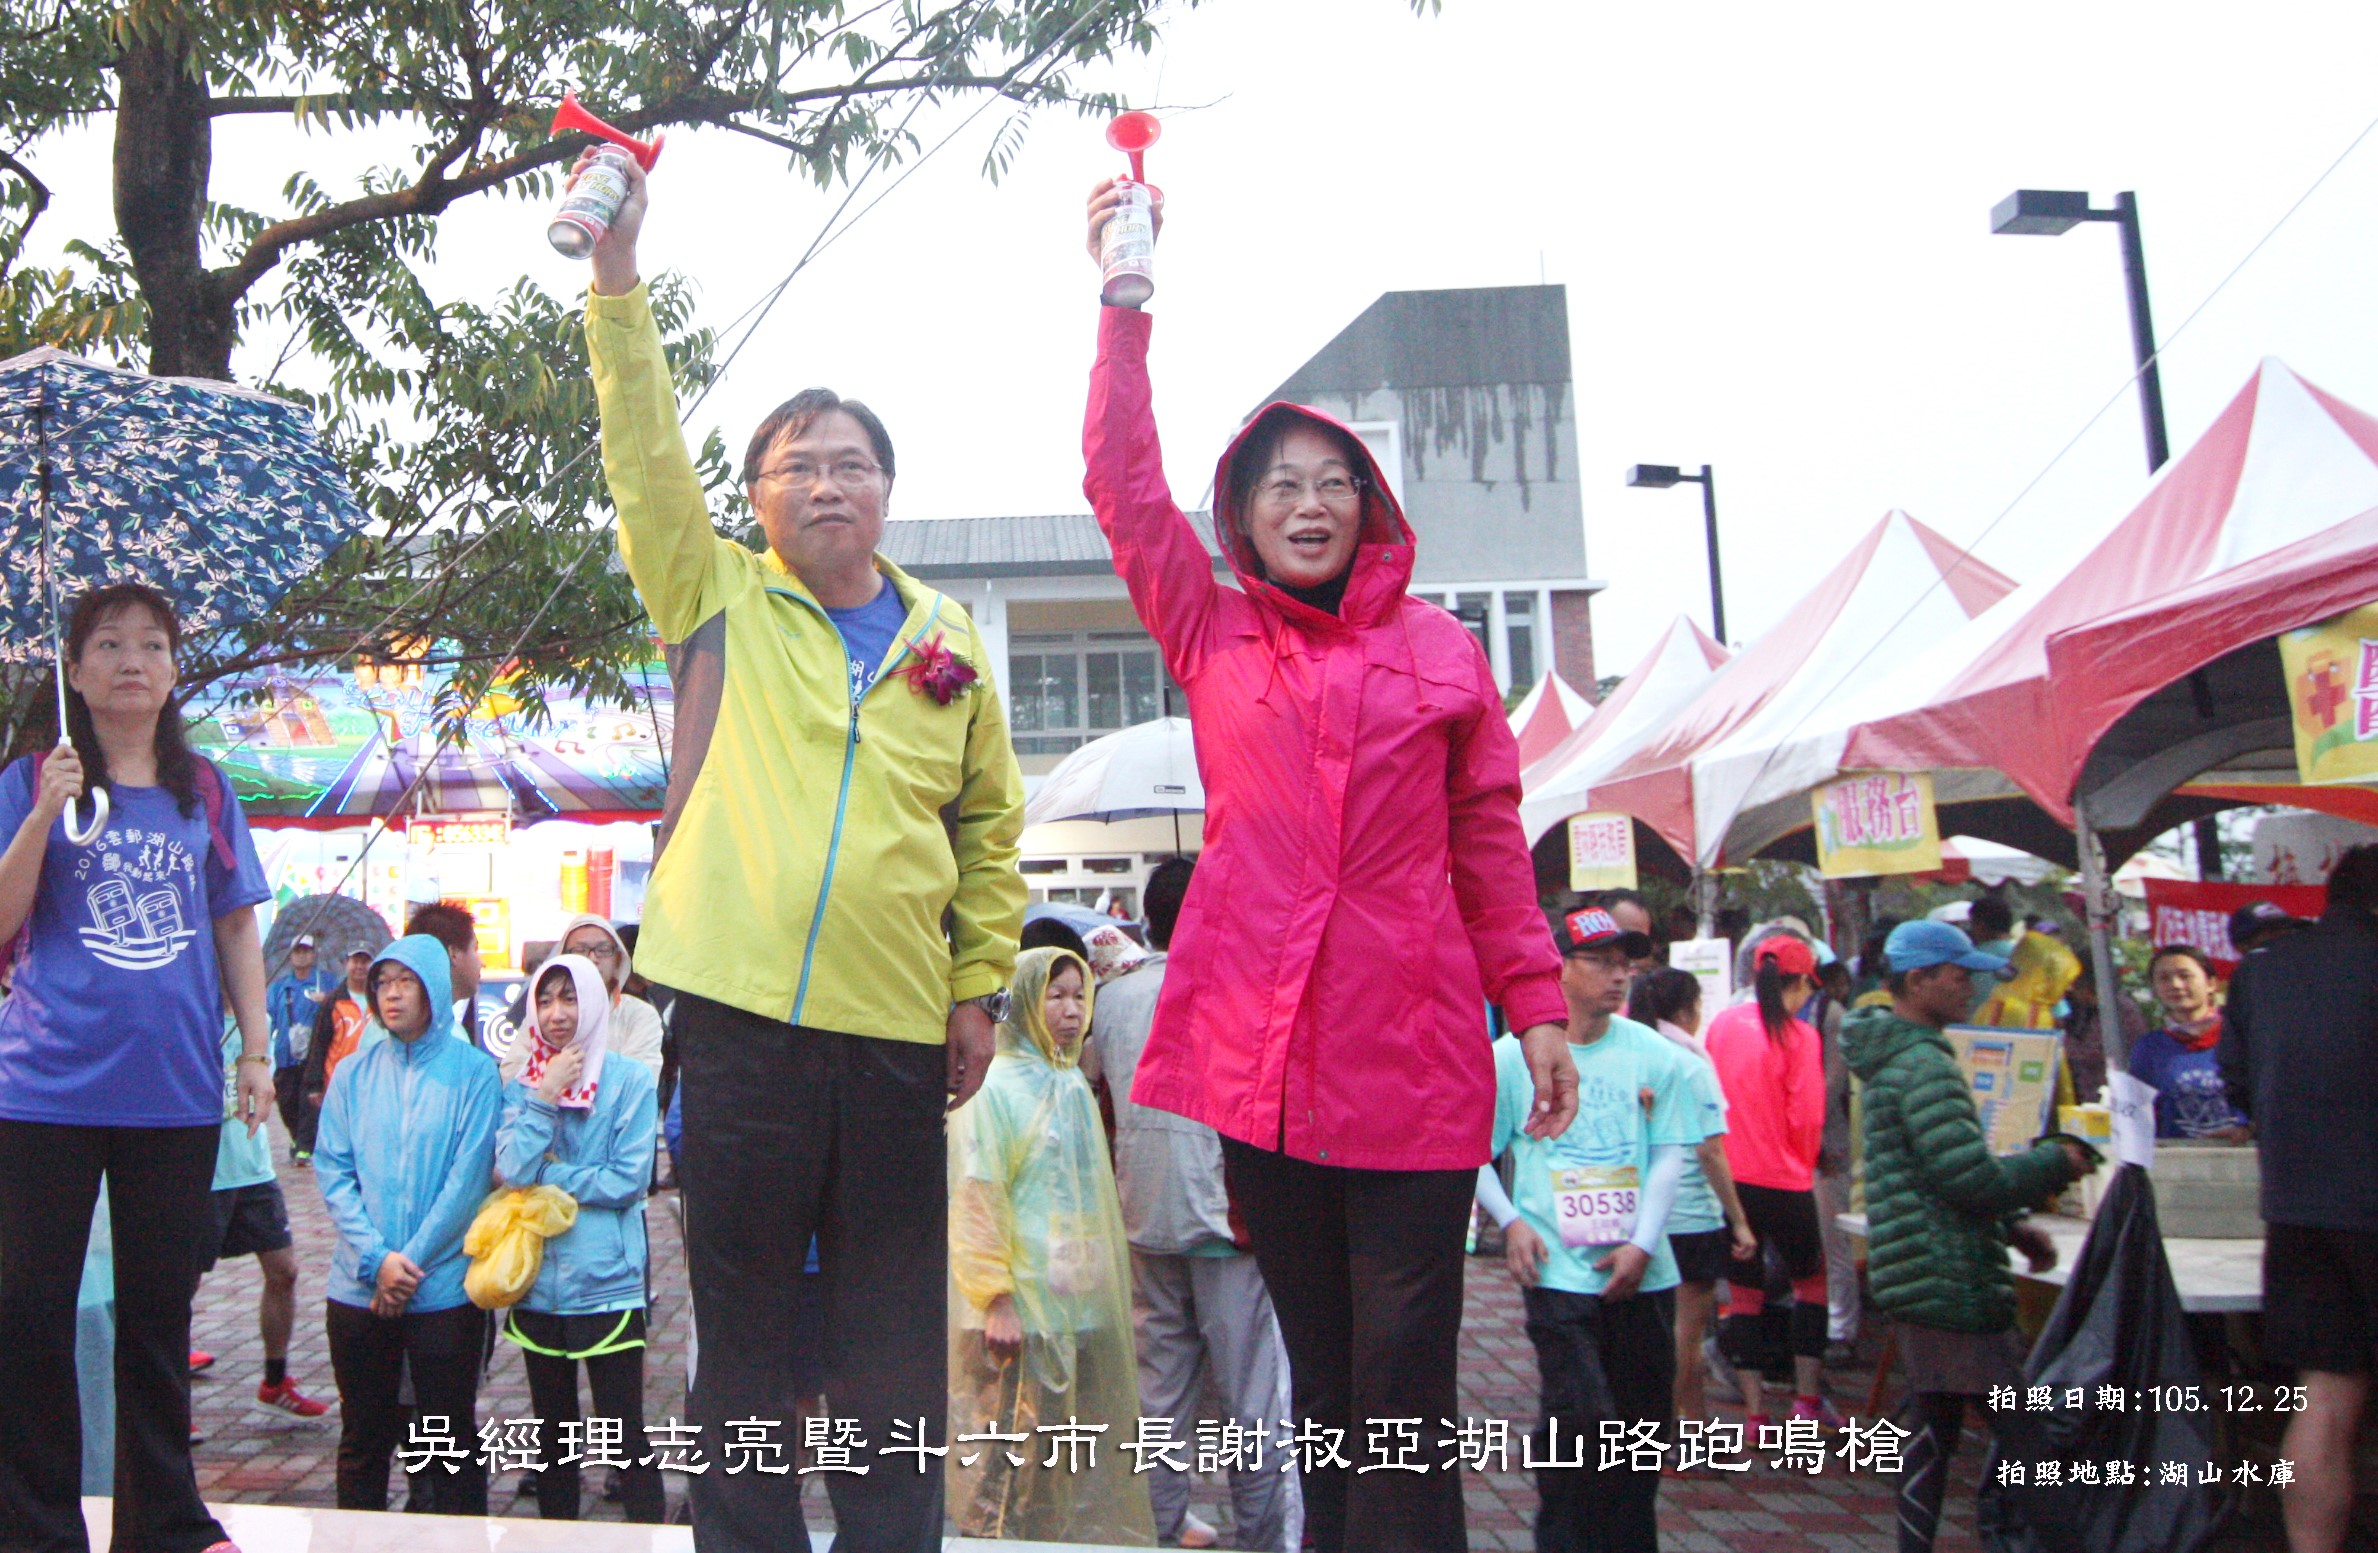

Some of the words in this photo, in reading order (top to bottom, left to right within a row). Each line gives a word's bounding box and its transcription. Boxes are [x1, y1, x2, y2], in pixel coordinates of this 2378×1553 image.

[1836, 772, 1921, 842] 服務台
[1563, 1190, 1636, 1218] 30538
